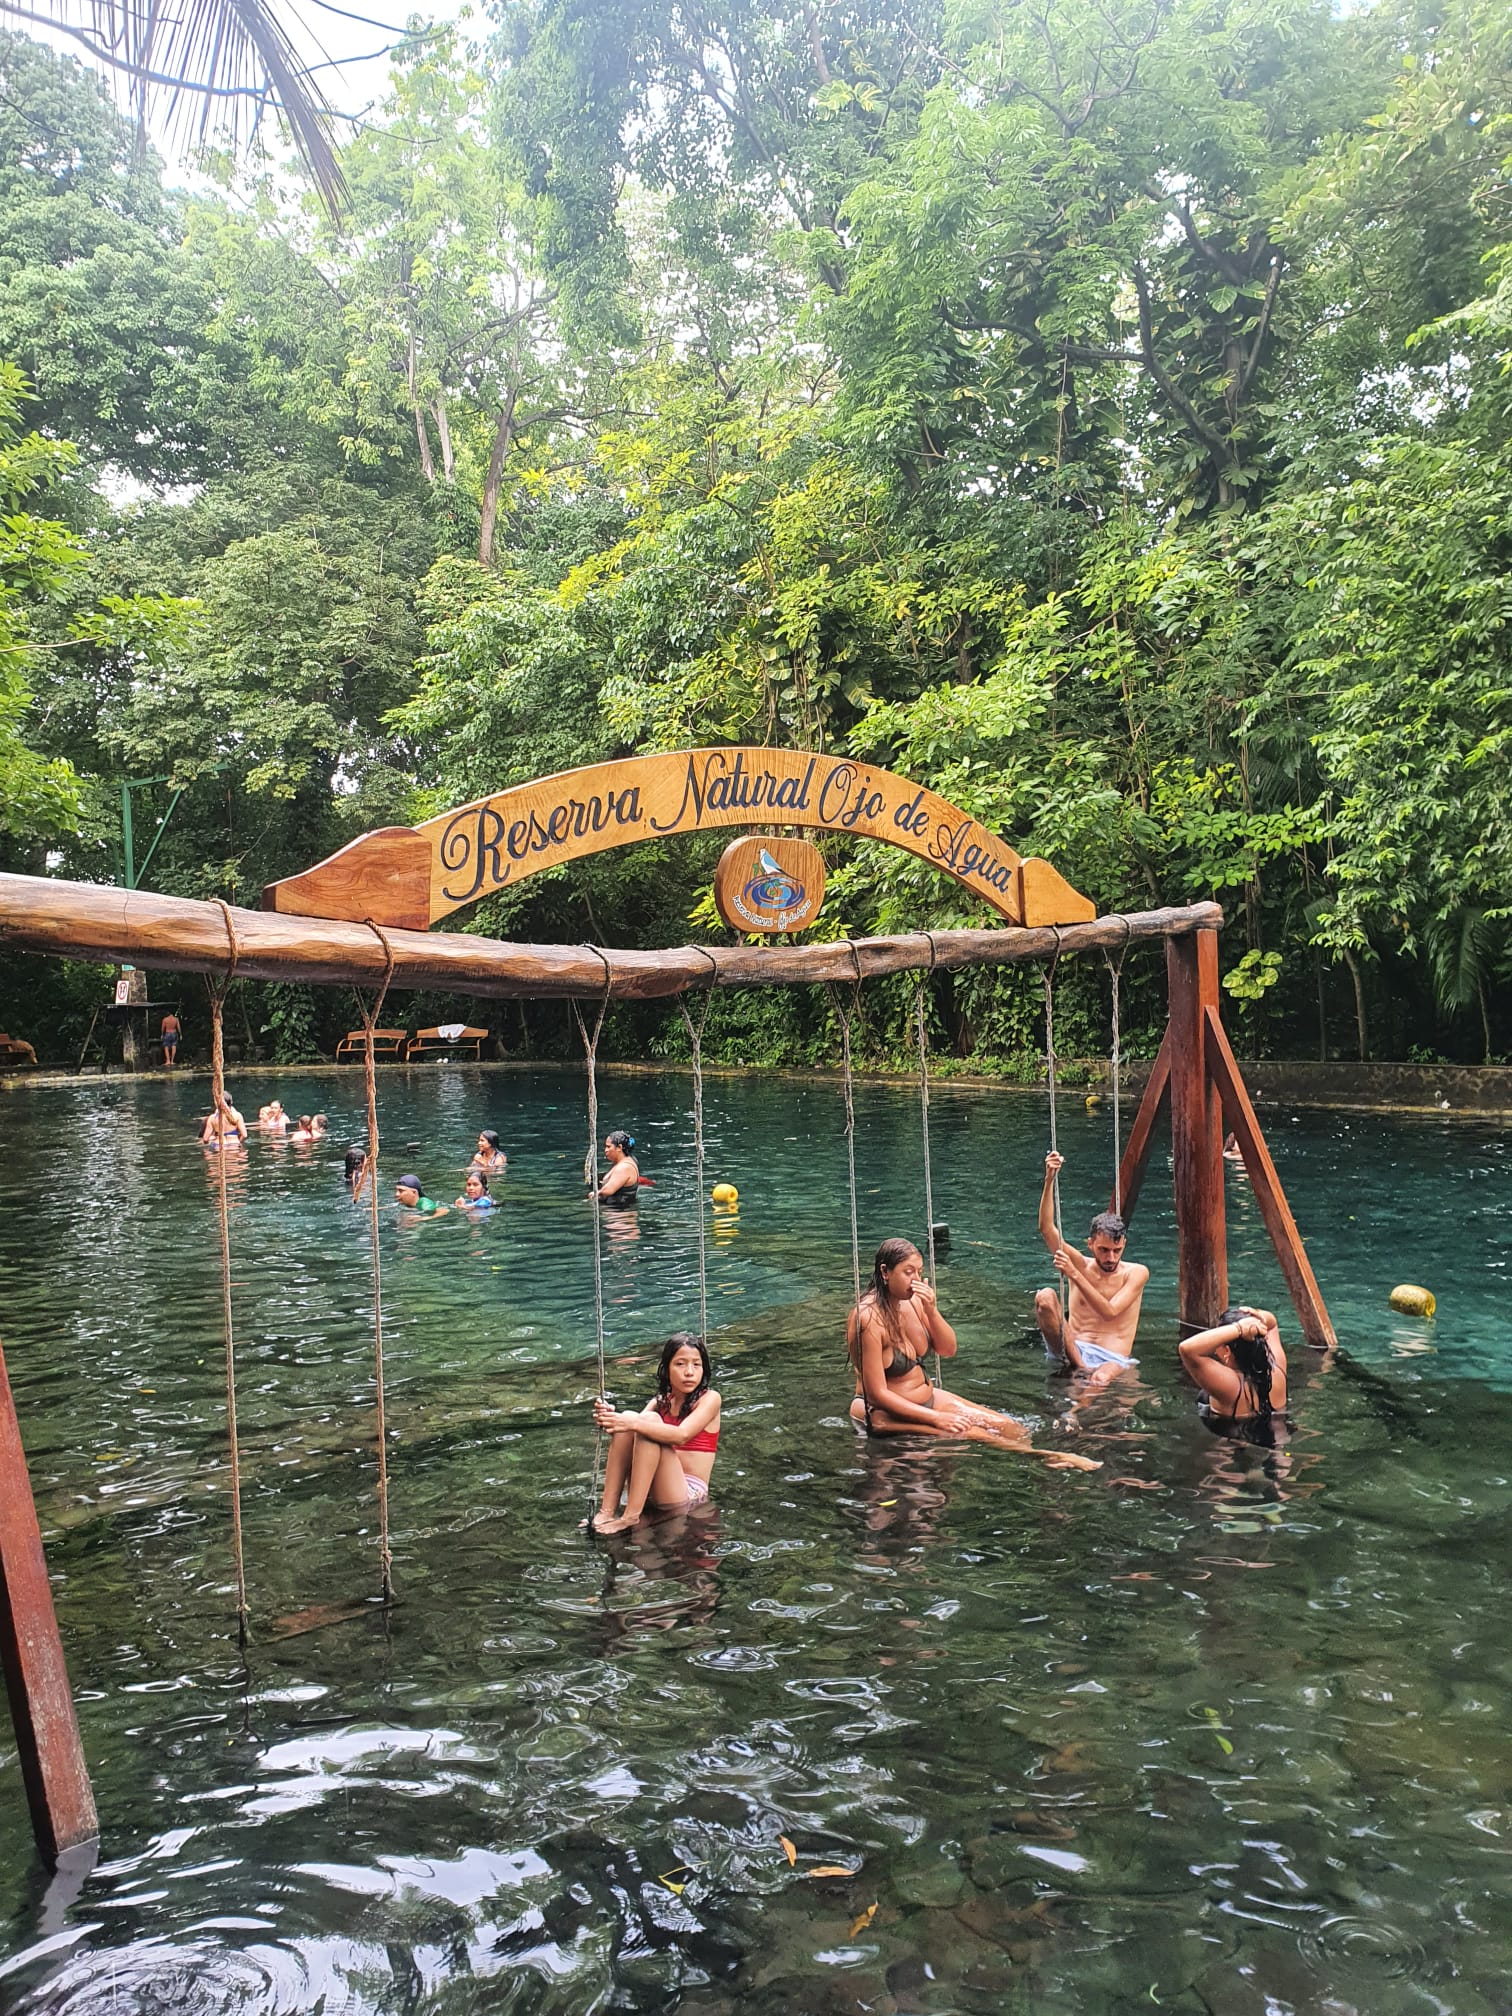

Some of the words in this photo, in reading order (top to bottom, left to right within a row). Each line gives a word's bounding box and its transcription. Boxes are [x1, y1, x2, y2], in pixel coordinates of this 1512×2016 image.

[440, 800, 643, 902] Reserva
[649, 752, 817, 832] Natural
[818, 763, 886, 828] Ojo
[893, 790, 930, 837] de
[927, 820, 1013, 893] Agua
